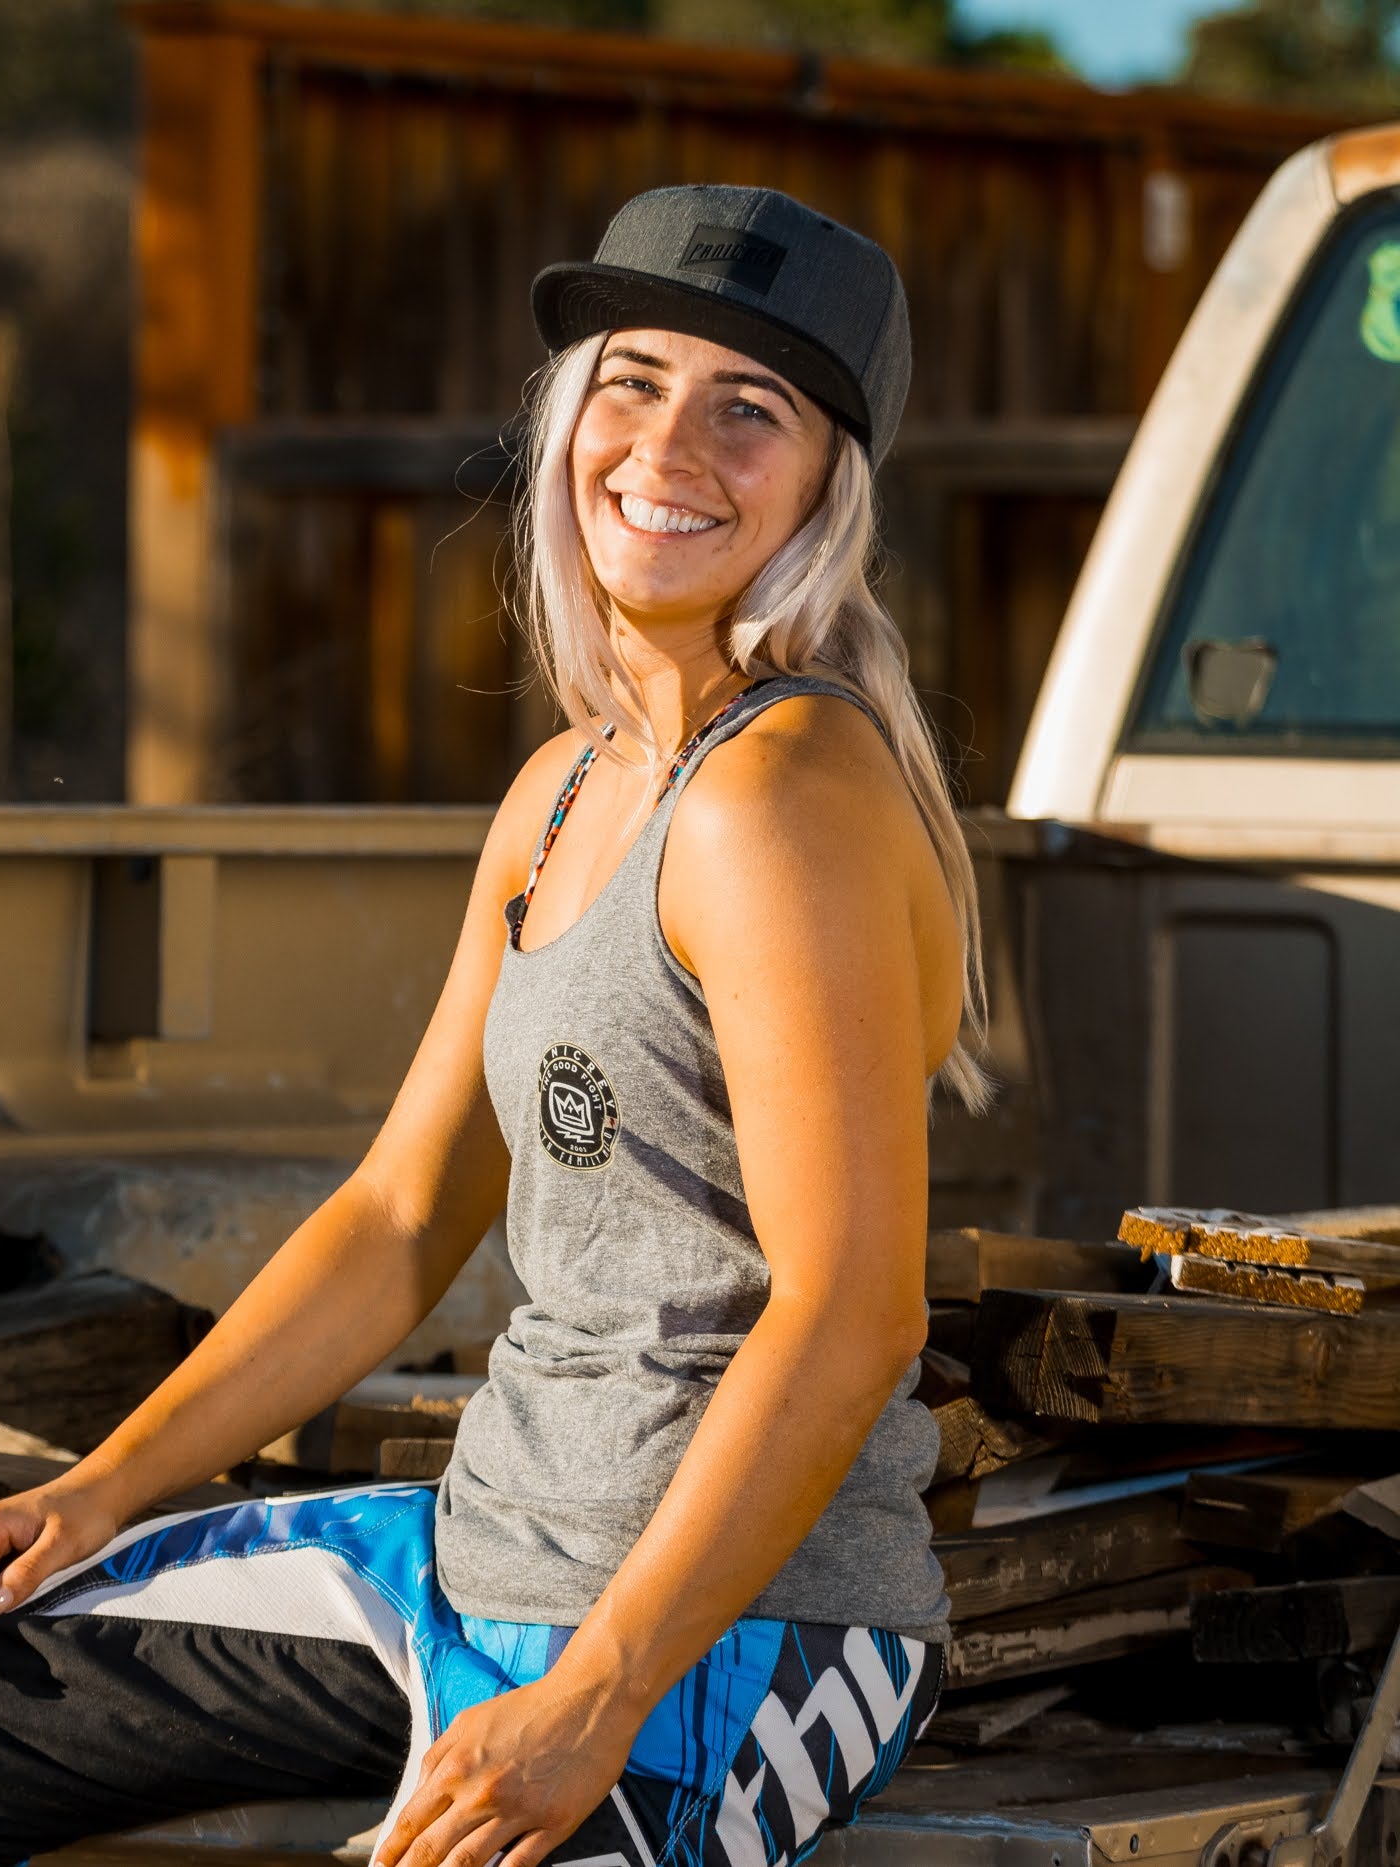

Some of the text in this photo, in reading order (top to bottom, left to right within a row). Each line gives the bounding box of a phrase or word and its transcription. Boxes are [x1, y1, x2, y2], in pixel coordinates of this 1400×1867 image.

[539, 1046, 616, 1109] ANICREV
[552, 1061, 578, 1073] GOOD
[581, 1072, 602, 1111] FIGHT
[559, 1151, 601, 1166] FAMILY
